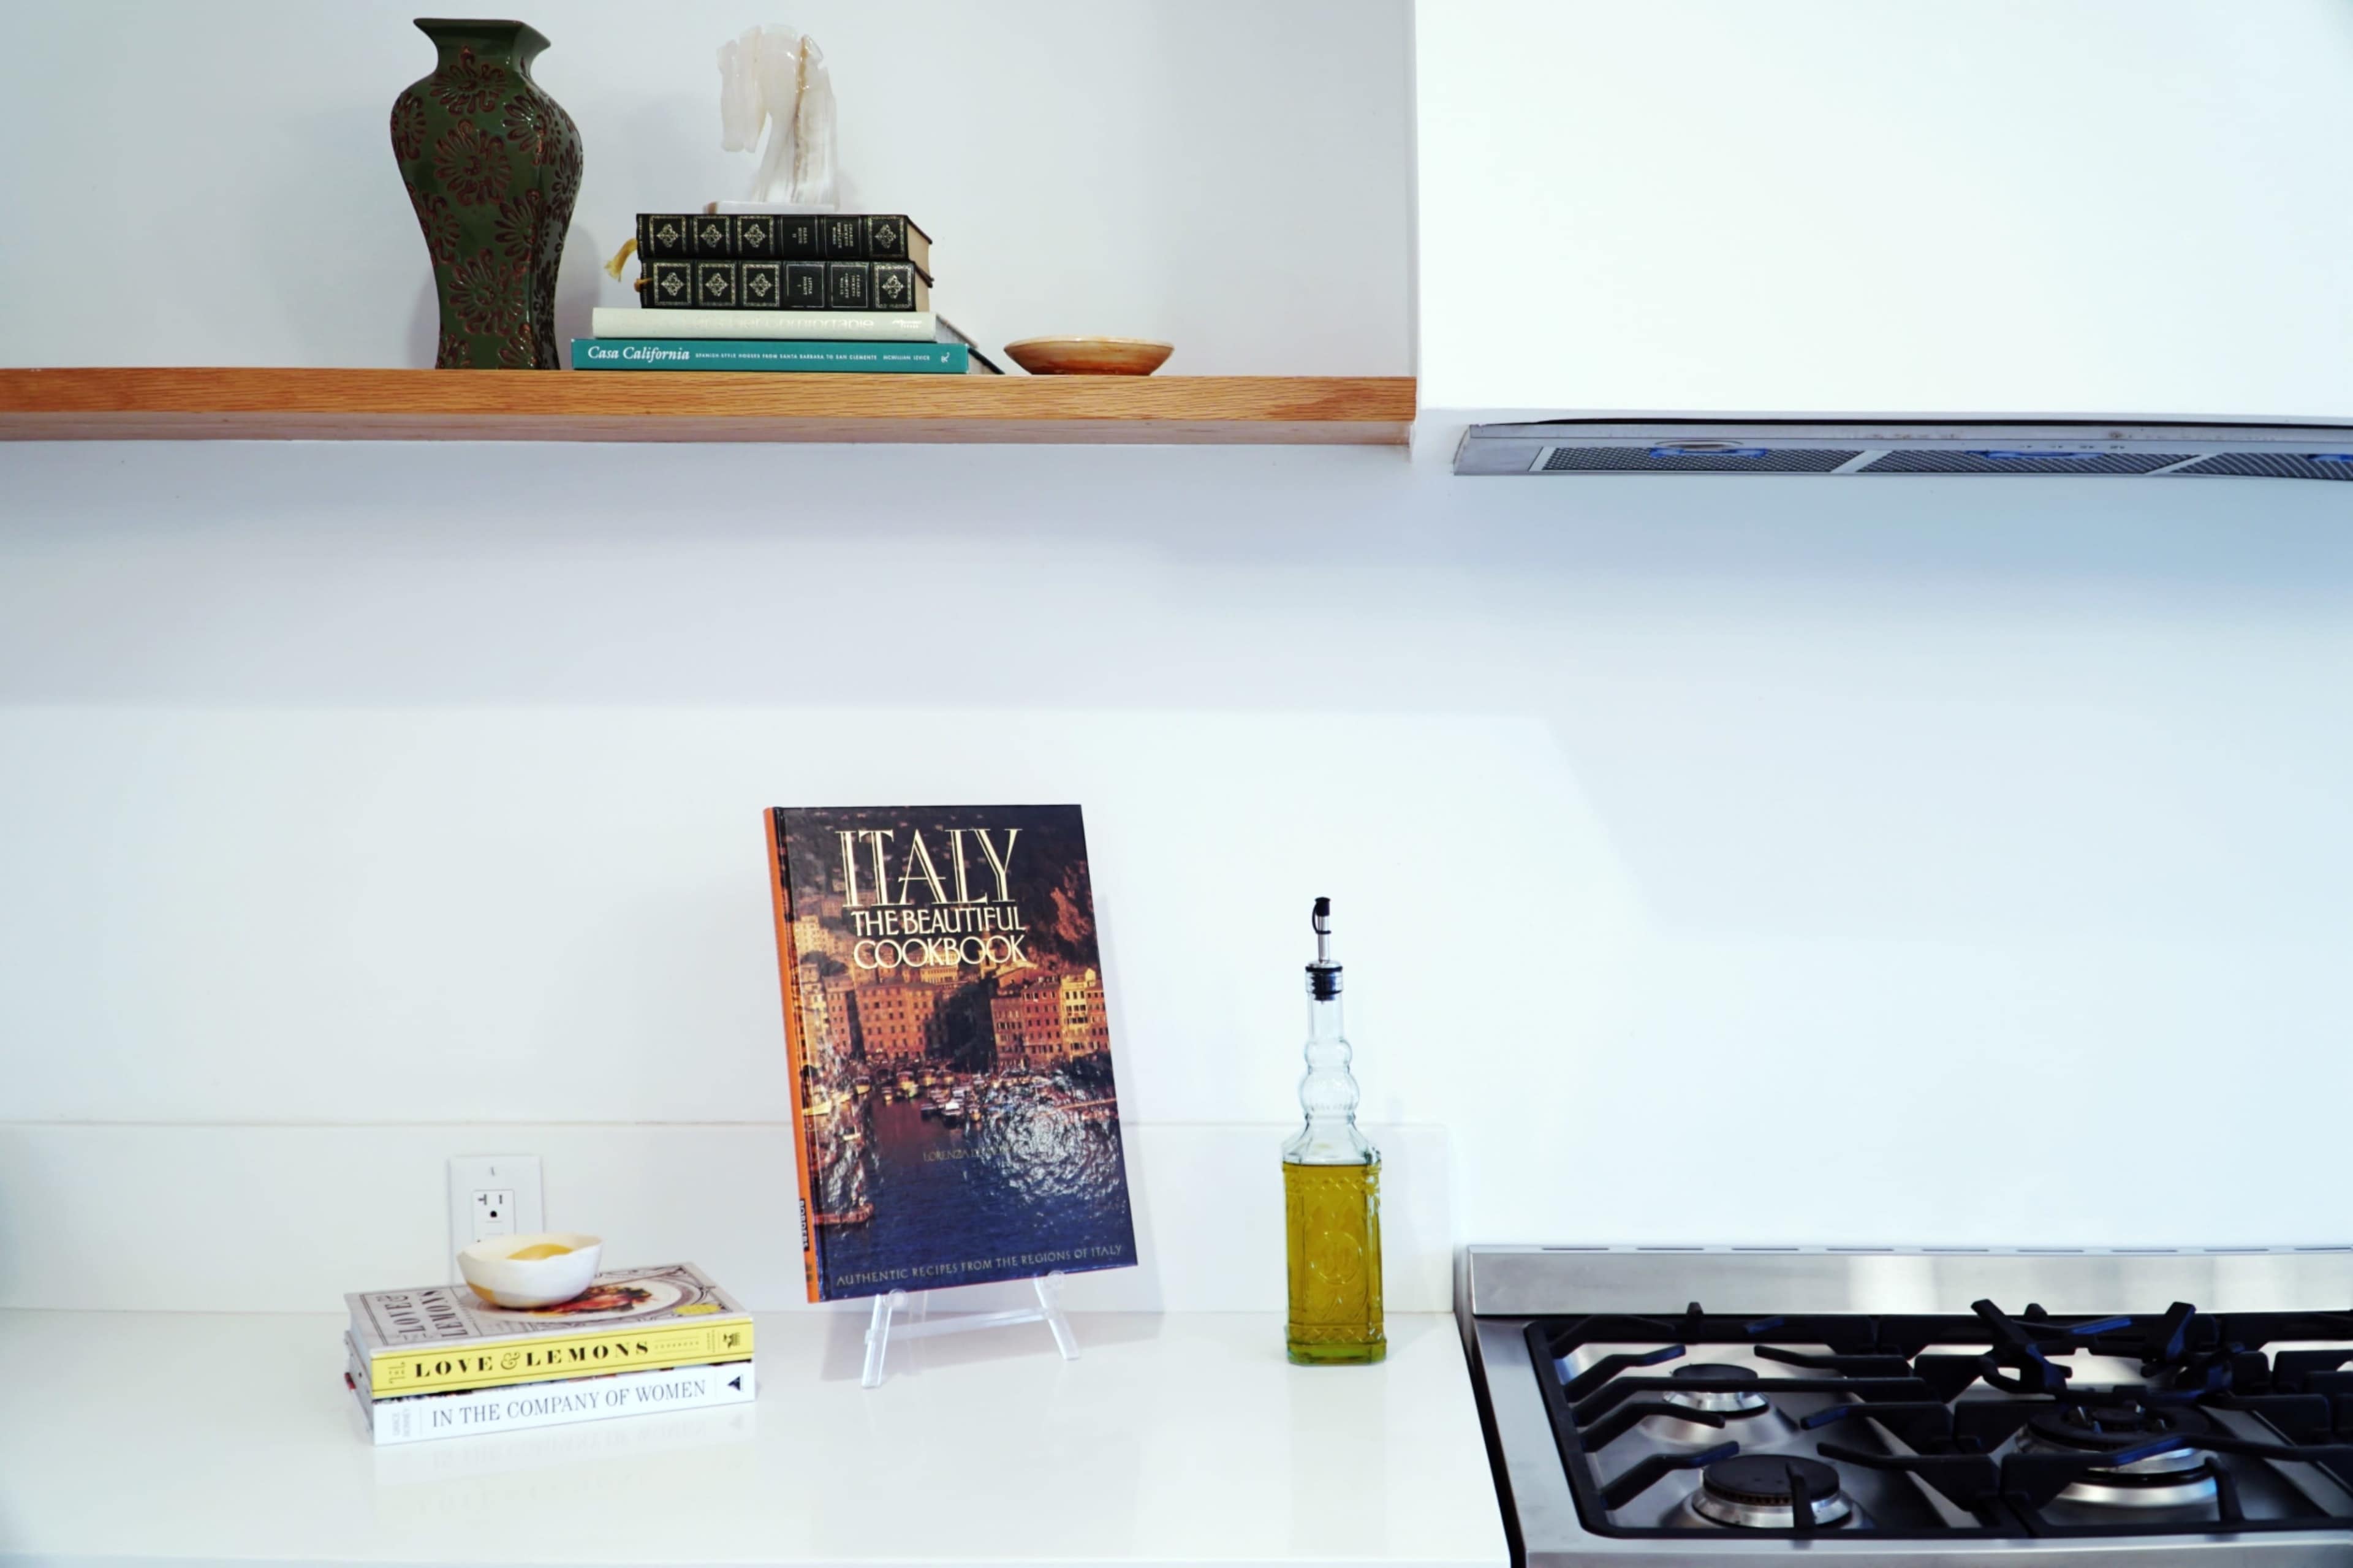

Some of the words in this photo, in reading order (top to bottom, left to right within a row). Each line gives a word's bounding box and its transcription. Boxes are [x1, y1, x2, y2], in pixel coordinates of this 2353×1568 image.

[588, 346, 619, 359] Casa
[623, 346, 690, 363] California
[835, 828, 1023, 907] ITALY
[851, 908, 899, 936] THE
[902, 907, 1026, 935] BEAUTIFUL
[853, 934, 1028, 969] COOKBOOK
[923, 1149, 969, 1162] LORENZA
[836, 1269, 909, 1286] AUTHENTIC
[912, 1263, 957, 1278] RECIPES
[961, 1260, 992, 1271] FROM
[996, 1256, 1018, 1268] THE
[1021, 1251, 1070, 1265] REGIONS
[1074, 1248, 1088, 1259] OF
[1091, 1245, 1121, 1256] ITALY
[384, 1303, 426, 1333] LOVE
[417, 1290, 468, 1337] LEMONS
[415, 1356, 493, 1377] LOVE
[501, 1352, 520, 1370] &
[526, 1341, 648, 1367] LEMONS
[433, 1409, 453, 1428] IN
[460, 1404, 500, 1423] THE
[507, 1392, 600, 1418] COMPANY
[605, 1388, 630, 1407] OF
[636, 1380, 705, 1403] WOMEN
